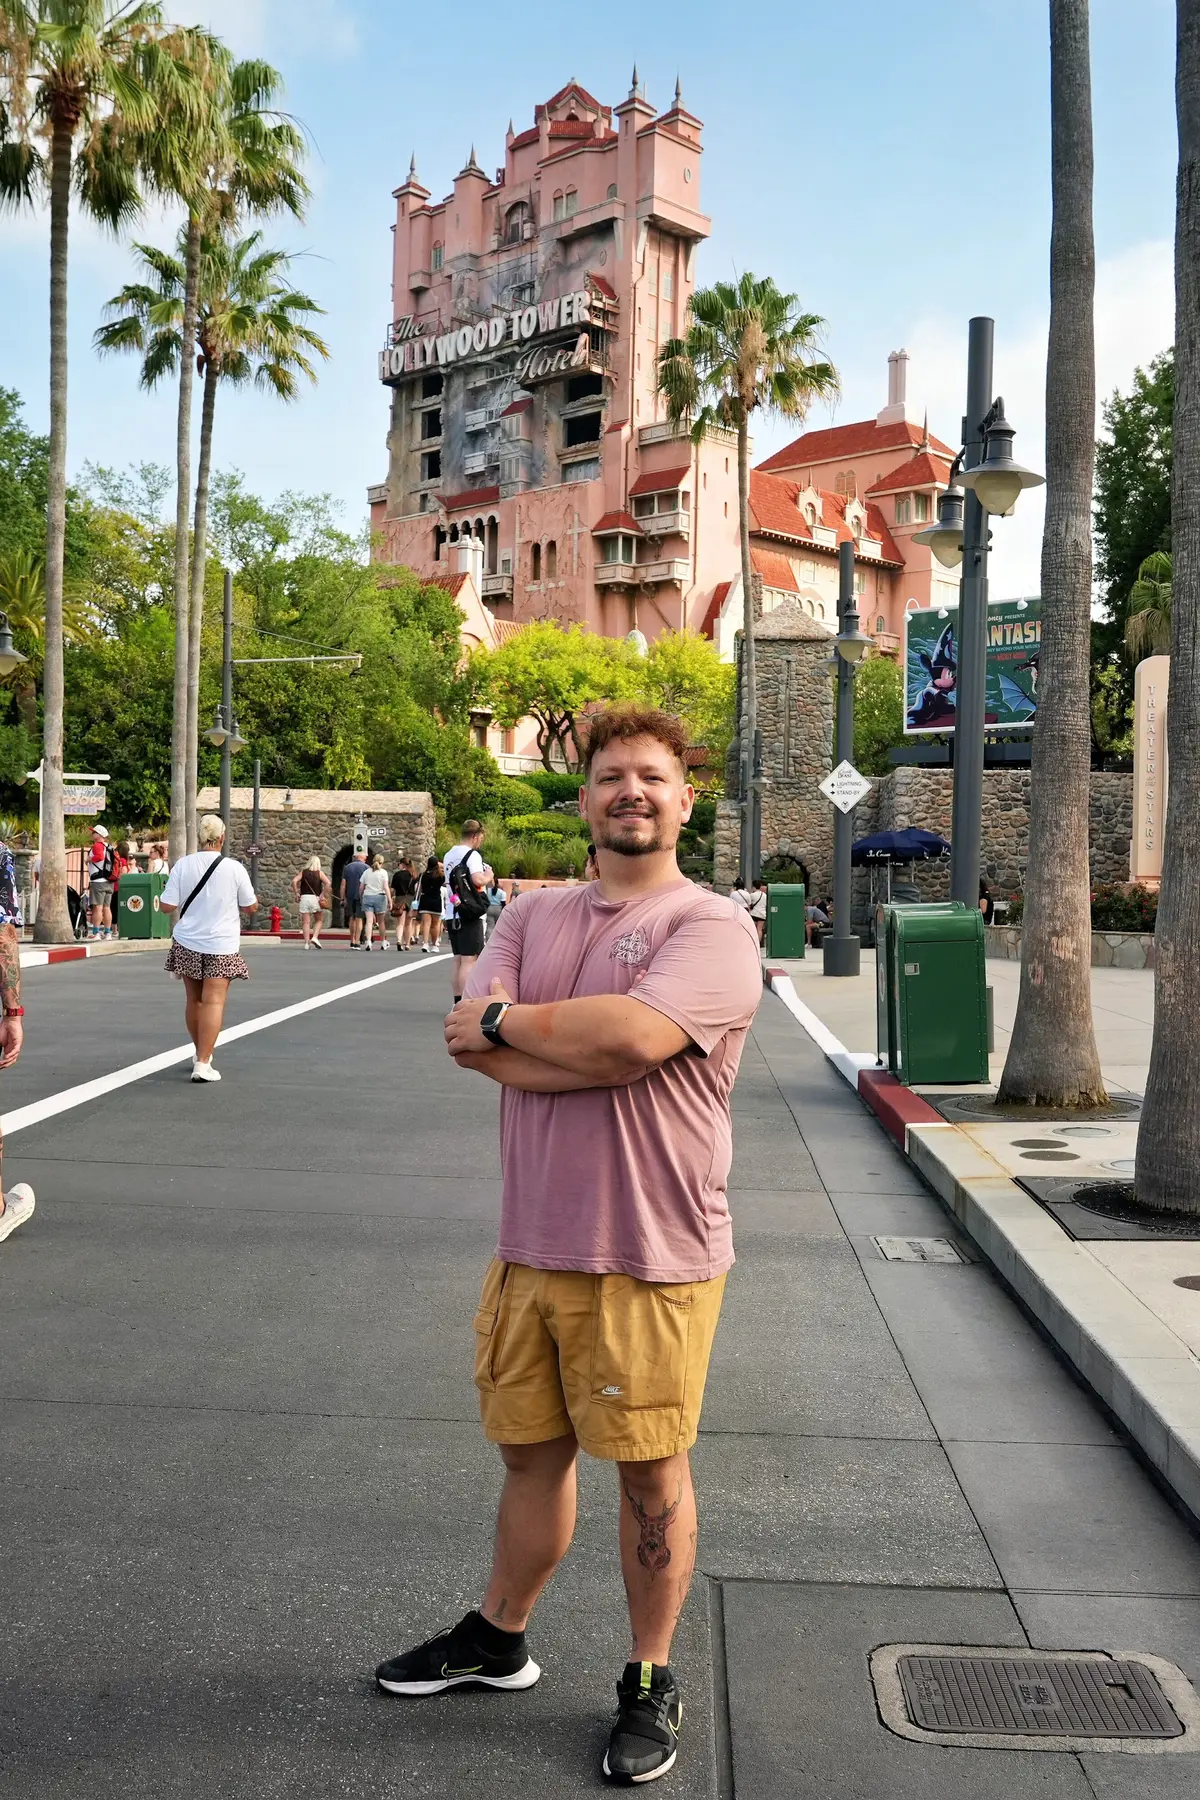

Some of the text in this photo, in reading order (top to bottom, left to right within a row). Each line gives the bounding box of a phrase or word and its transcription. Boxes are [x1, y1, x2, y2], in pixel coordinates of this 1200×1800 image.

[378, 290, 591, 380] HOLLYWOOD TOWER
[392, 314, 424, 343] The
[514, 332, 589, 384] Hotel
[986, 620, 1041, 646] NTAS
[1146, 685, 1156, 774] THEATER
[63, 796, 104, 807] COOPS
[1145, 790, 1155, 850] STARS
